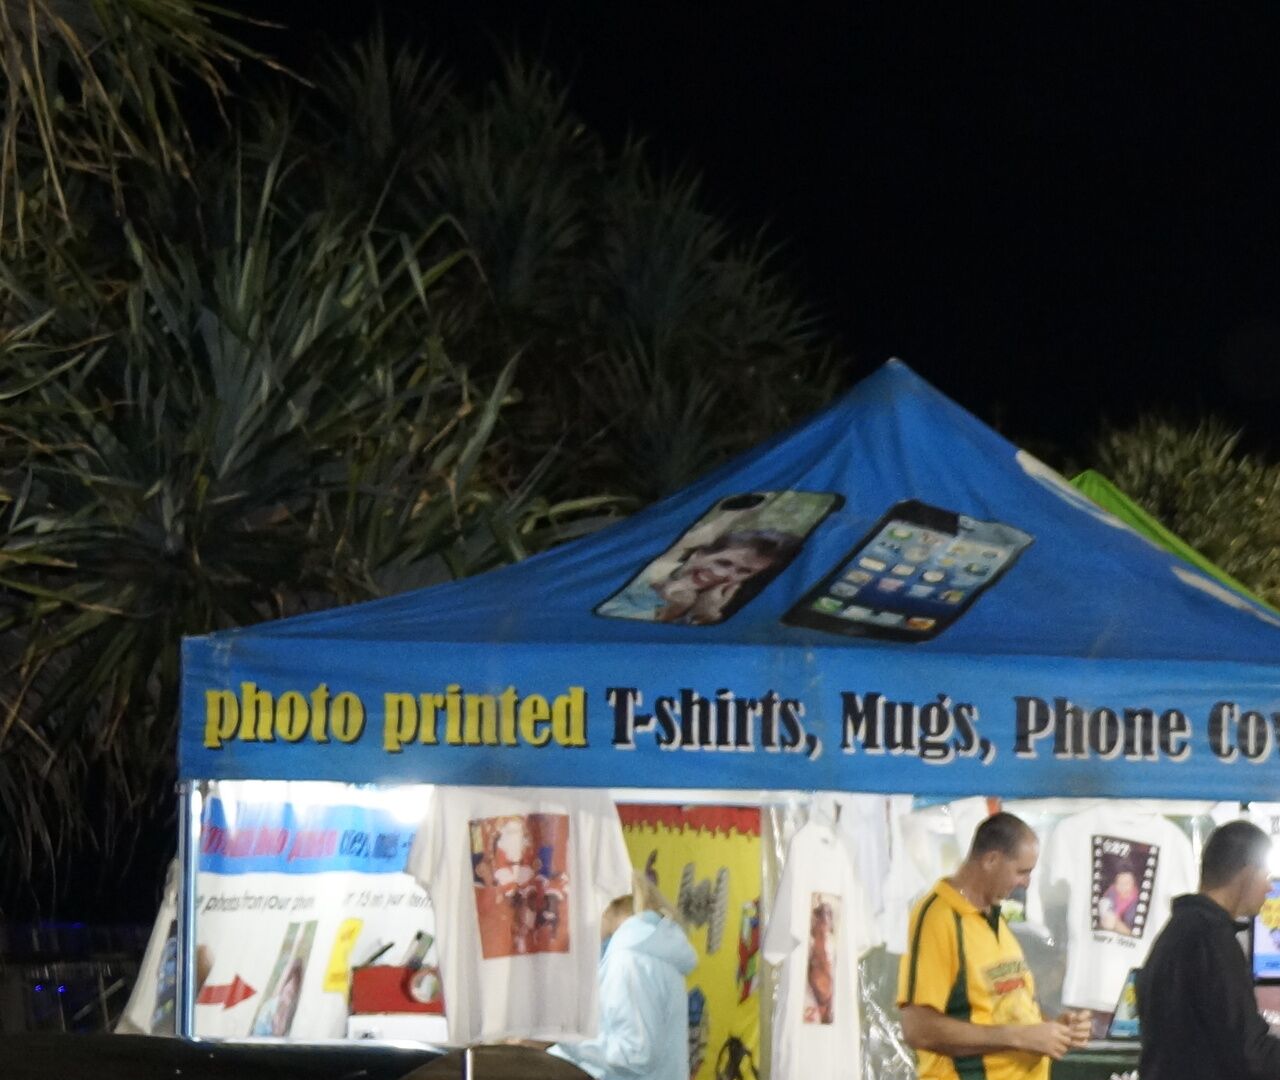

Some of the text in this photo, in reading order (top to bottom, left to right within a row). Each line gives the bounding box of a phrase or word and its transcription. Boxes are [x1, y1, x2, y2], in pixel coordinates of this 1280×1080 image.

[204, 682, 367, 749] photo
[383, 684, 590, 754] printed
[605, 685, 823, 761] T-shirts,
[839, 691, 996, 765] Mugs,
[1012, 695, 1191, 763] Phone
